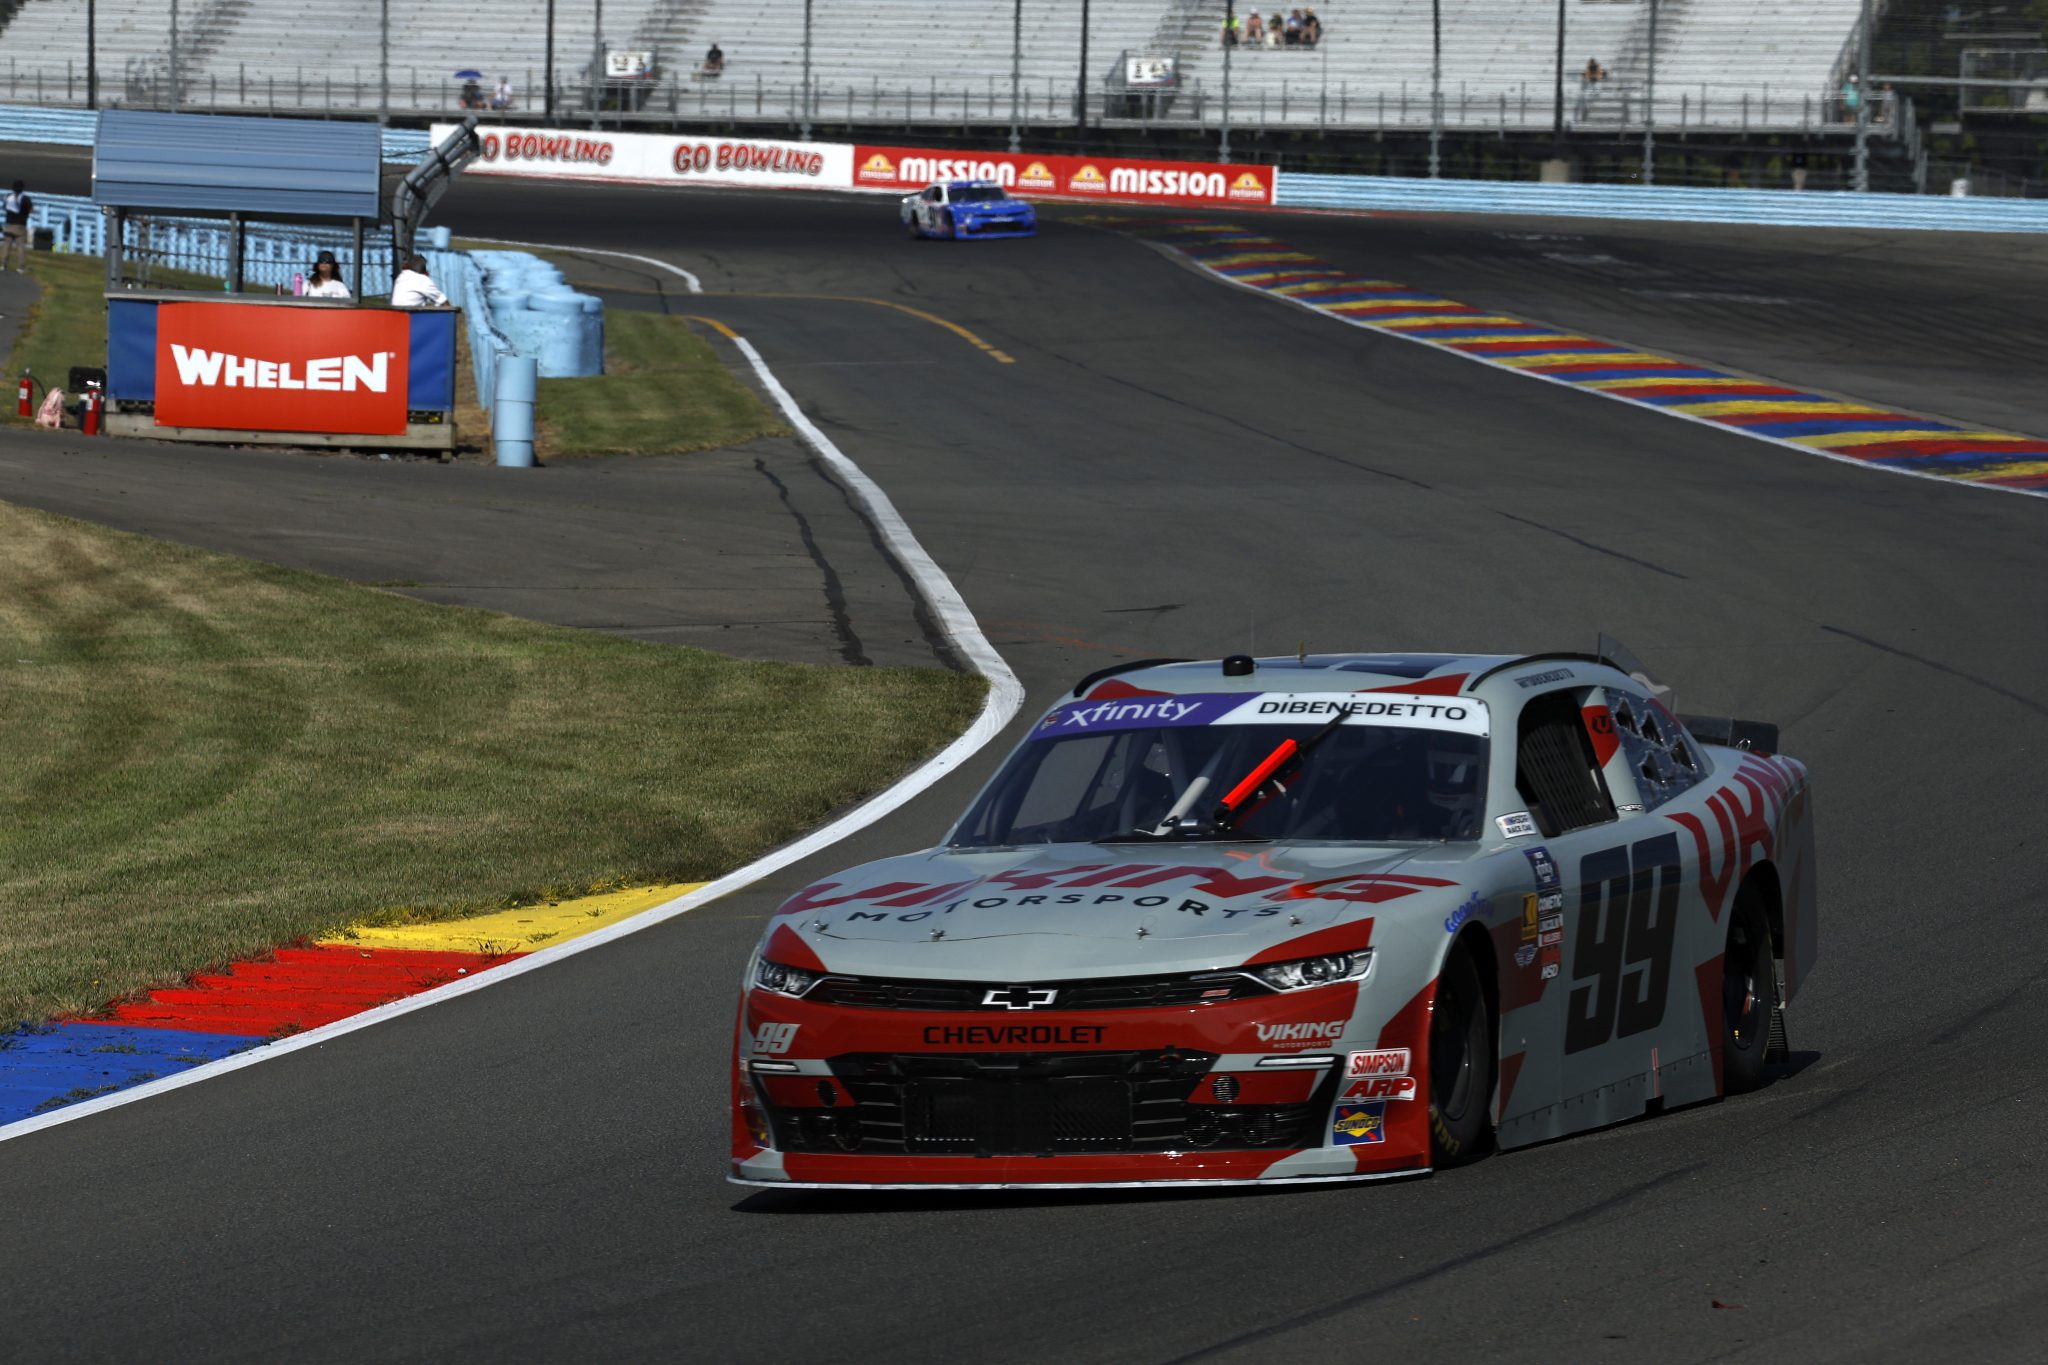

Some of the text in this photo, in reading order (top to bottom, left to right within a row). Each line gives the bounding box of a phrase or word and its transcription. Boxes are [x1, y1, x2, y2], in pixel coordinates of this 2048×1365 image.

[505, 133, 613, 165] BOWLING
[673, 143, 824, 176] GO BOWLING
[900, 157, 1016, 187] MISSION
[1110, 167, 1226, 197] MISSION
[170, 343, 389, 393] WHELEN
[1258, 701, 1468, 721] DIBENEDETTO
[846, 894, 1284, 922] MOTORSPORTS
[1565, 832, 1681, 1056] 99
[754, 1022, 802, 1054] 99
[922, 1025, 1109, 1044] CHEVROLET
[1256, 1020, 1345, 1042] VIKING
[1272, 1040, 1332, 1049] MOTORSPORTS
[1352, 1053, 1406, 1075] SIMPSON
[1343, 1077, 1415, 1098] ARP
[1335, 1117, 1379, 1132] SUNOCO
